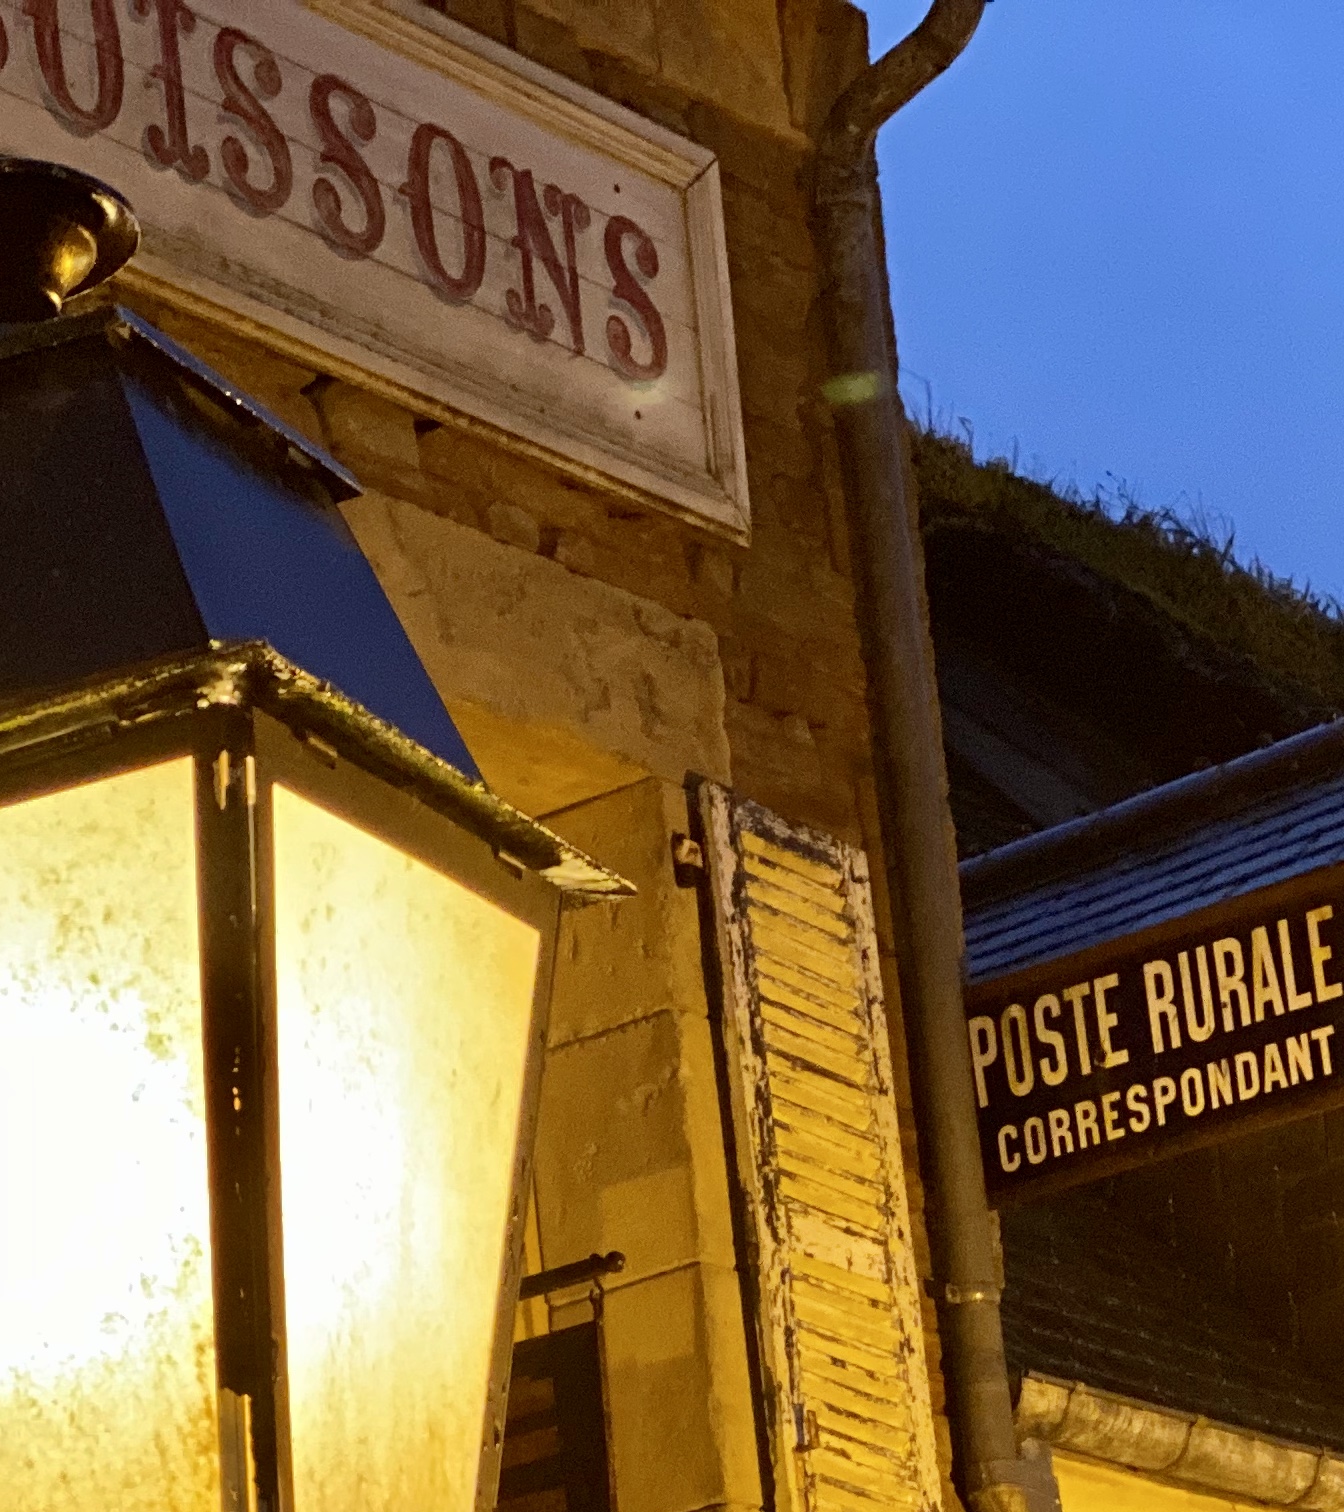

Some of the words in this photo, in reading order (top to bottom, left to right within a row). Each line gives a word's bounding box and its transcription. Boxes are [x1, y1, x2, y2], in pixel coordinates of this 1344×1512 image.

[968, 973, 1129, 1108] POSTE
[1143, 905, 1343, 1054] RURALE
[998, 1025, 1335, 1173] CORRESPONDANT
